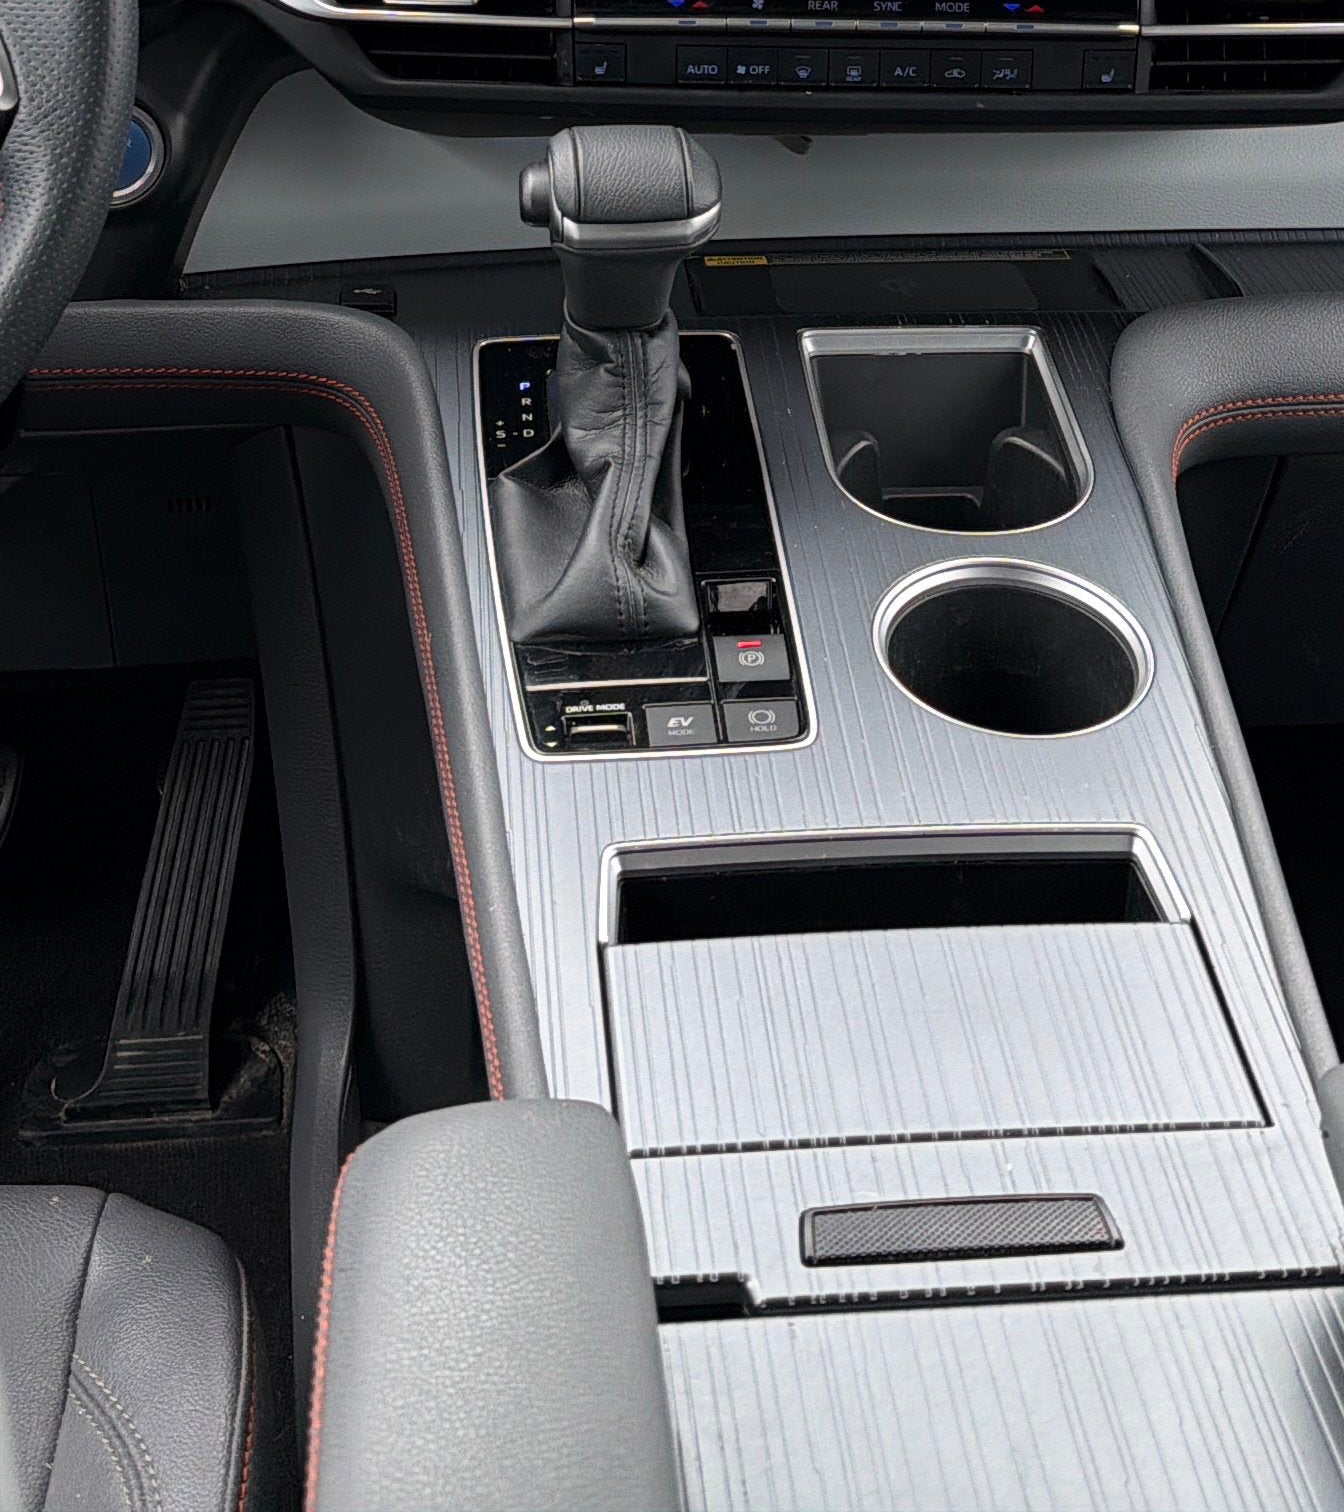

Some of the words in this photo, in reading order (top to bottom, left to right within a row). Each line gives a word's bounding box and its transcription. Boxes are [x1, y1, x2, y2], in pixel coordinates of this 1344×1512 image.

[808, 0, 838, 10] REAR
[874, 1, 902, 11] SYNC
[935, 2, 970, 12] MODE
[687, 65, 718, 75] AUTO
[749, 65, 771, 75] OFF
[894, 66, 916, 76] A/C
[520, 382, 530, 391] P
[521, 397, 532, 406] R
[521, 413, 533, 421] N
[496, 430, 506, 439] S
[523, 429, 534, 437] D
[565, 705, 594, 713] DRIVE
[596, 703, 625, 711] MODE
[667, 717, 694, 727] EV
